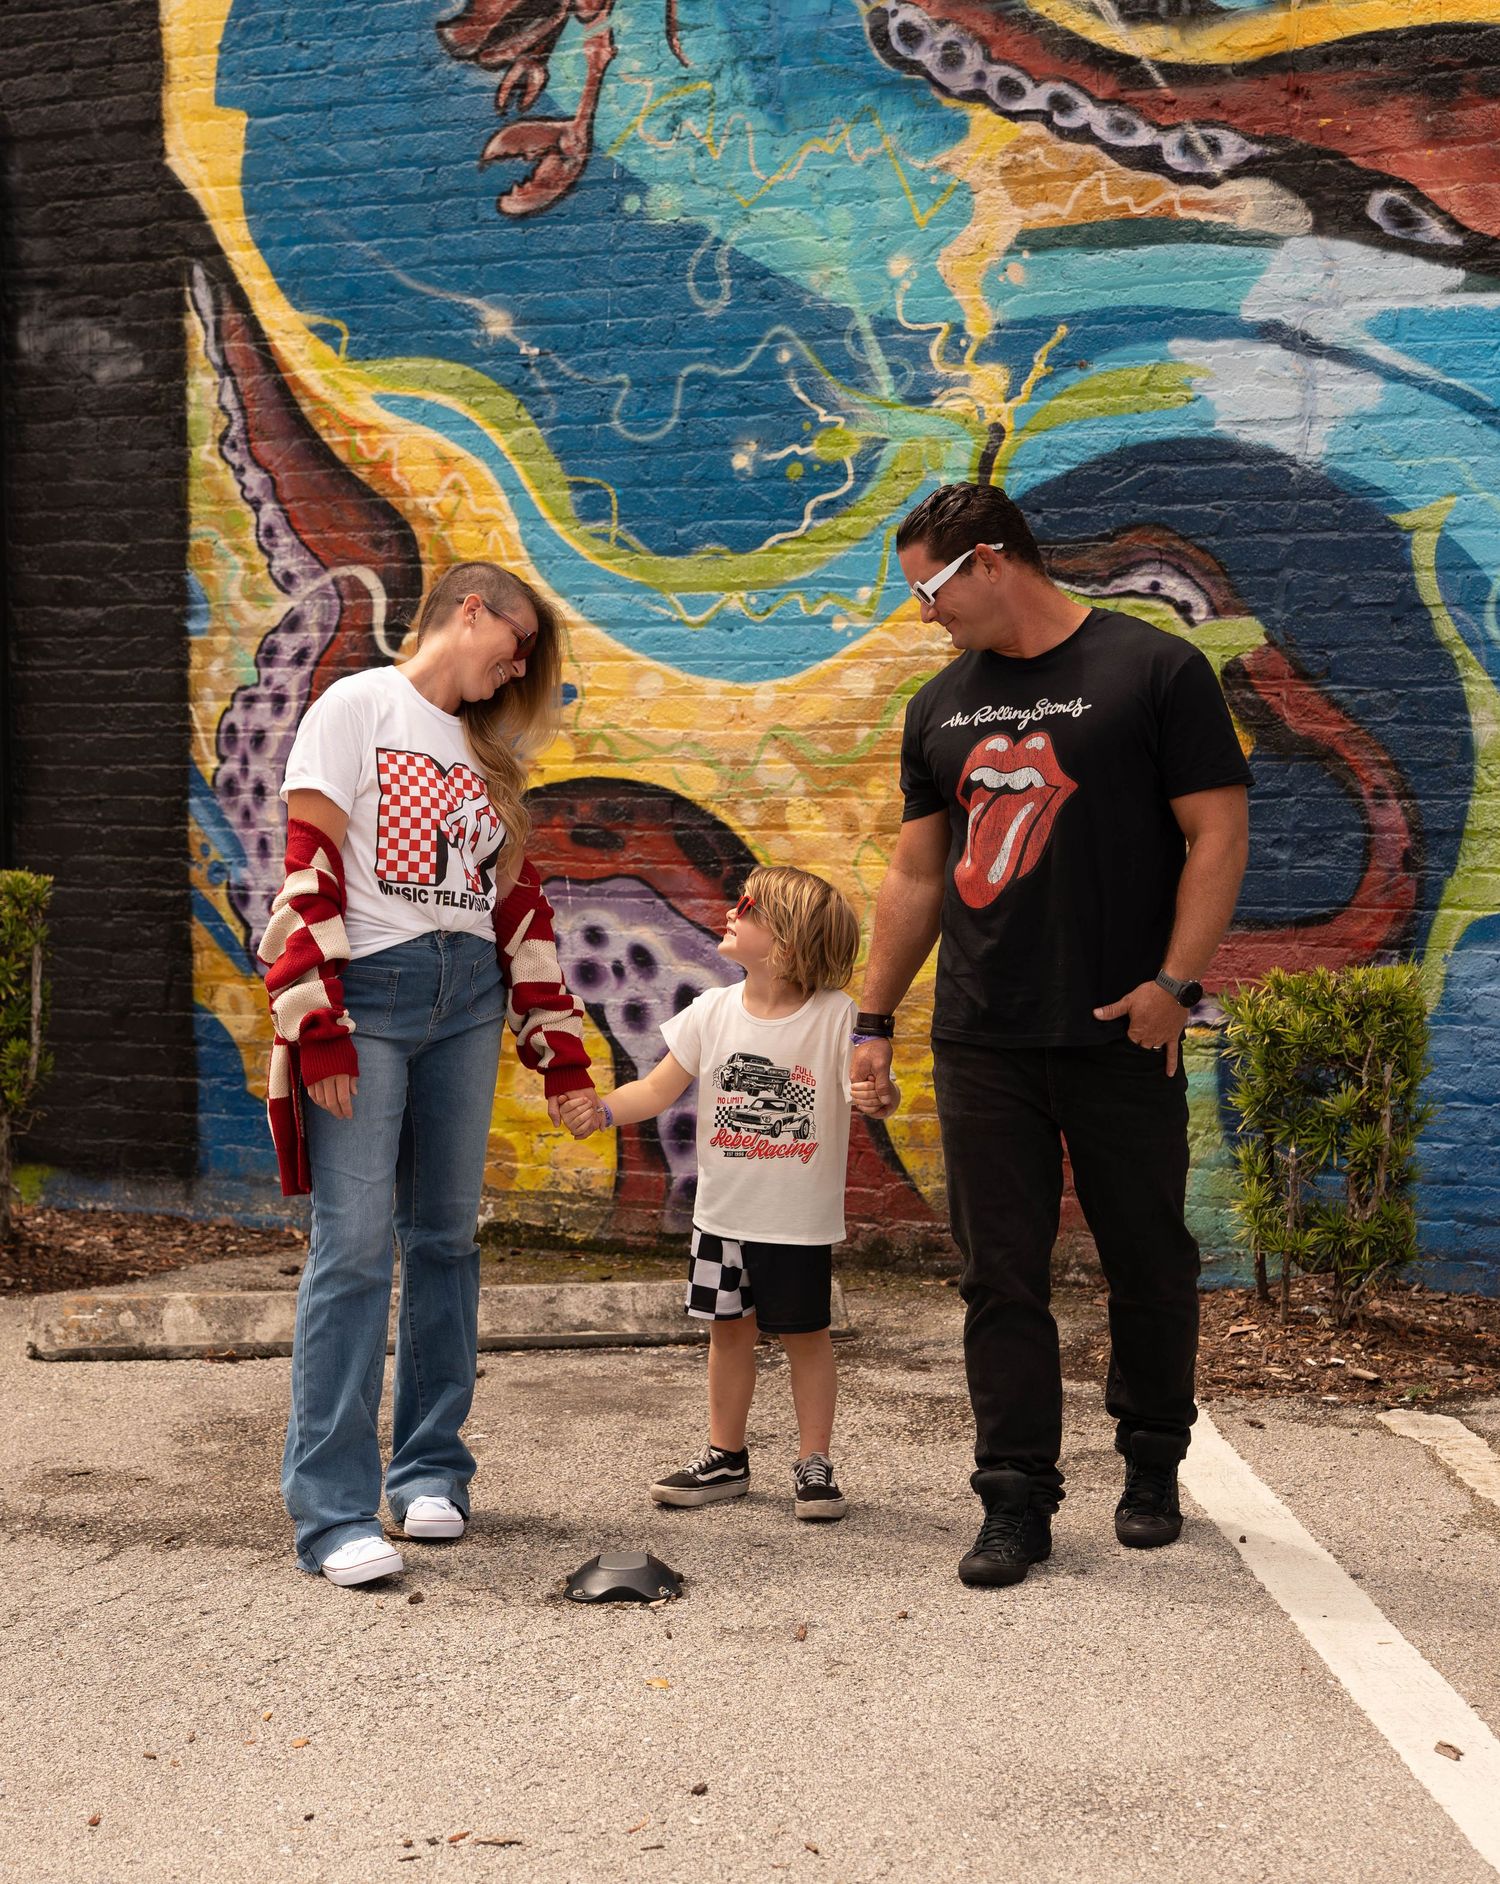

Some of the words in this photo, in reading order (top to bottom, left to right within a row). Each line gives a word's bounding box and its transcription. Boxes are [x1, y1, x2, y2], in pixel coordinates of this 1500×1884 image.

[941, 711, 971, 728] the
[970, 705, 1033, 731] Rolling
[1031, 697, 1092, 721] Stones
[795, 1065, 814, 1078] FULL
[791, 1073, 817, 1087] SPEED
[717, 1096, 726, 1105] NO
[727, 1096, 744, 1104] LIMIT
[710, 1128, 761, 1149] Rebel
[746, 1138, 819, 1164] Racing
